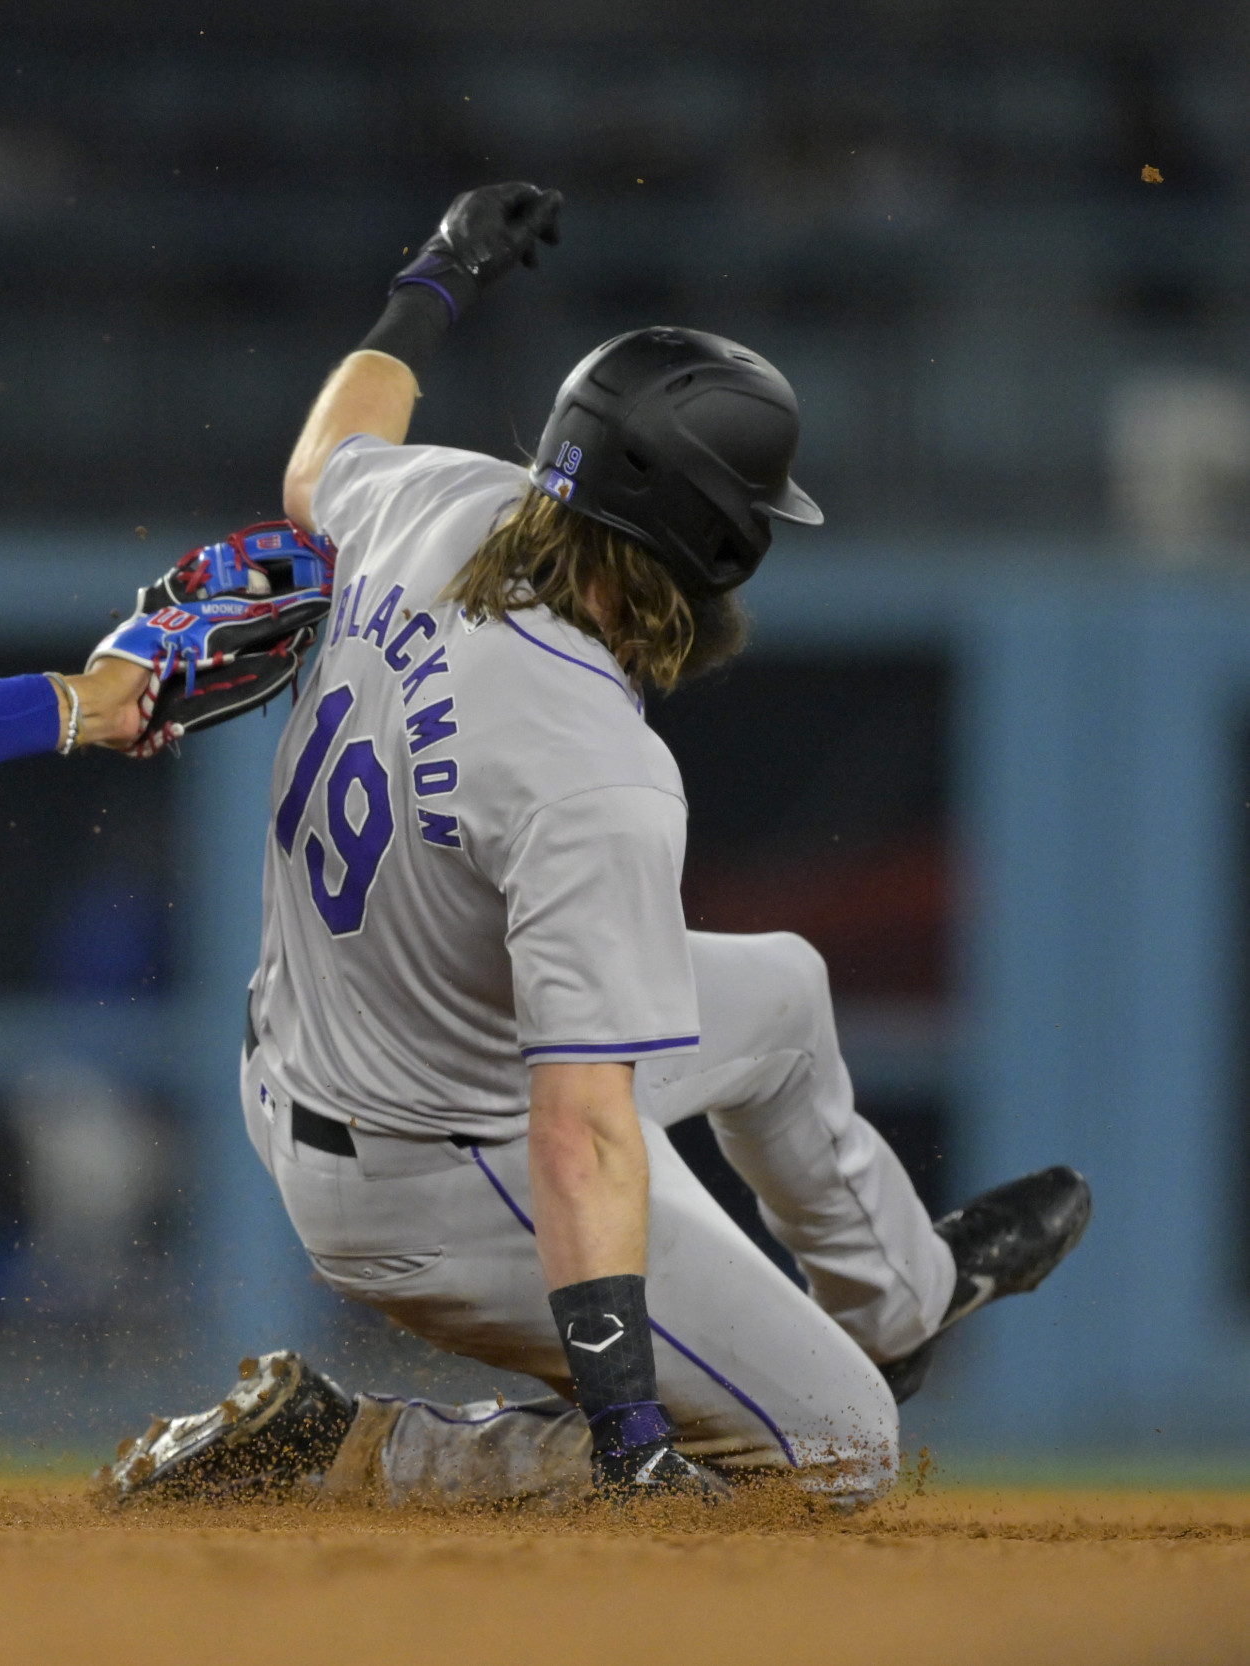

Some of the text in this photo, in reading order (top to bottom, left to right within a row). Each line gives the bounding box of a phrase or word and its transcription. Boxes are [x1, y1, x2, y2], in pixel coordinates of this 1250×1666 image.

[555, 440, 583, 476] 19
[201, 603, 244, 615] MOOKIE
[329, 574, 463, 850] BLACKMON
[275, 680, 395, 939] 19
